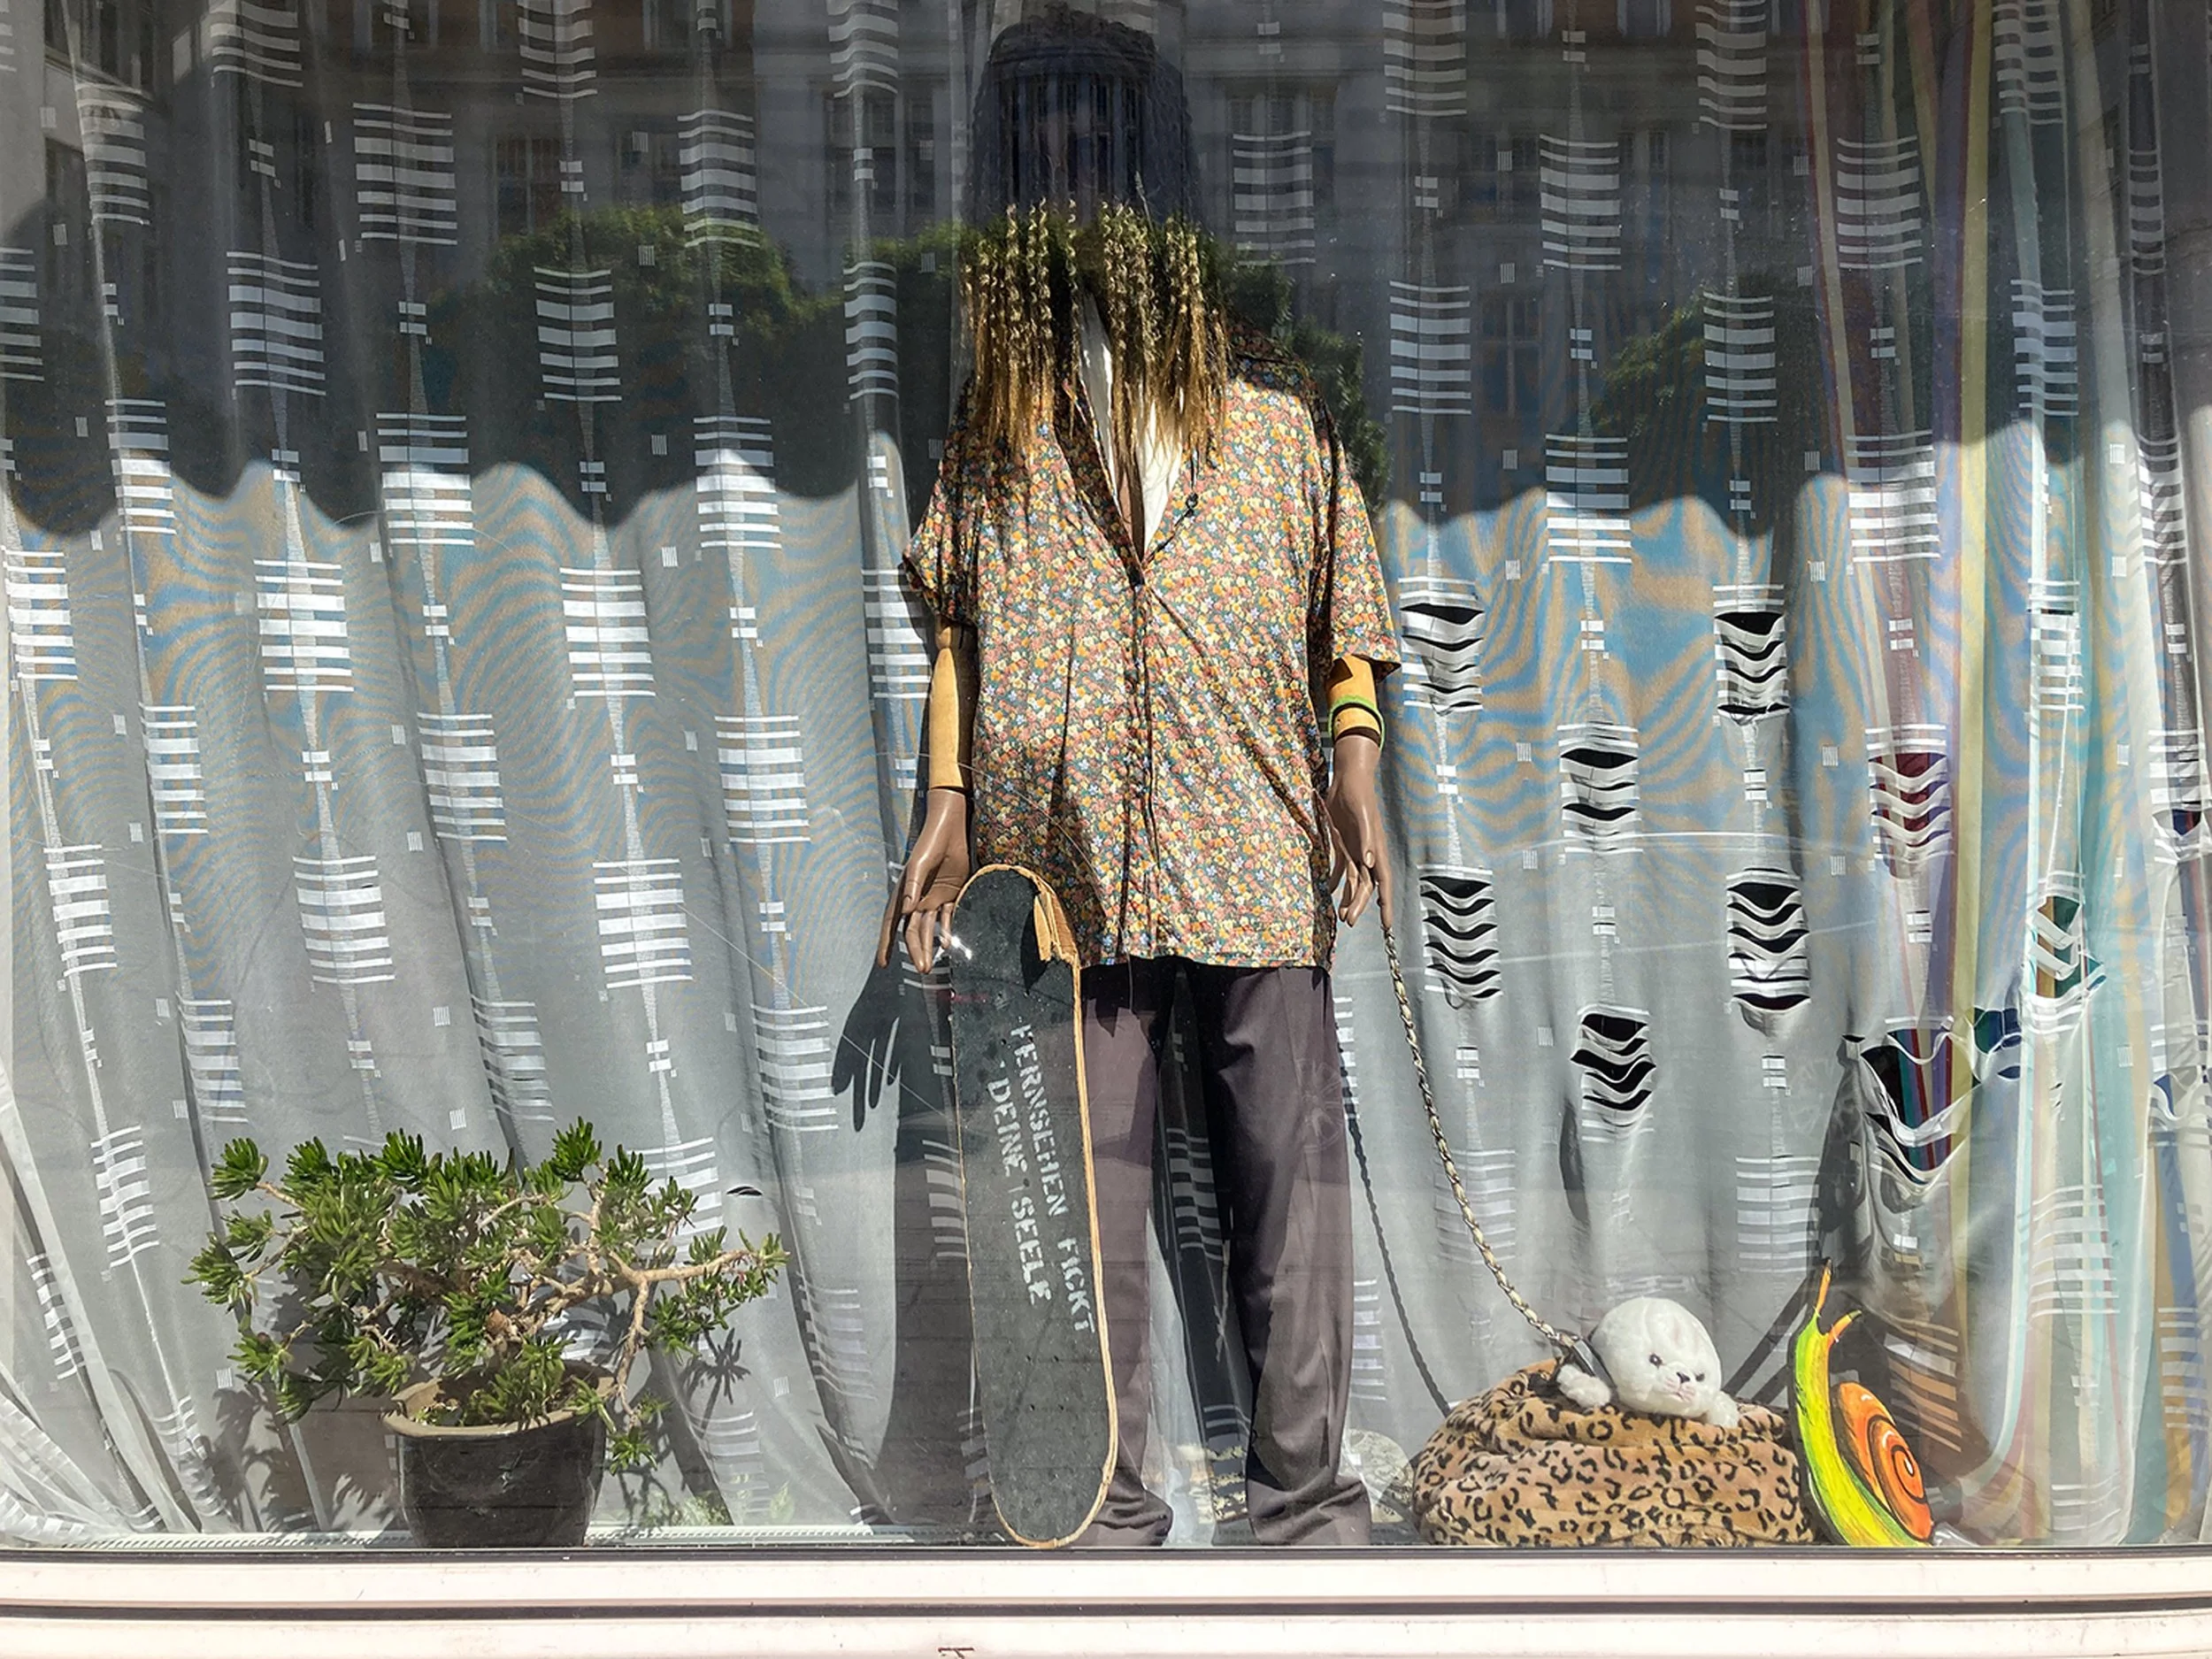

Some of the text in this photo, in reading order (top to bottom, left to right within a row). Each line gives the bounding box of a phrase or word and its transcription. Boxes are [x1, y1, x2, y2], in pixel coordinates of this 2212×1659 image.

[987, 1078, 1052, 1305] DEINE SEELE
[1010, 1023, 1095, 1333] FERNSEHEN FICKT
